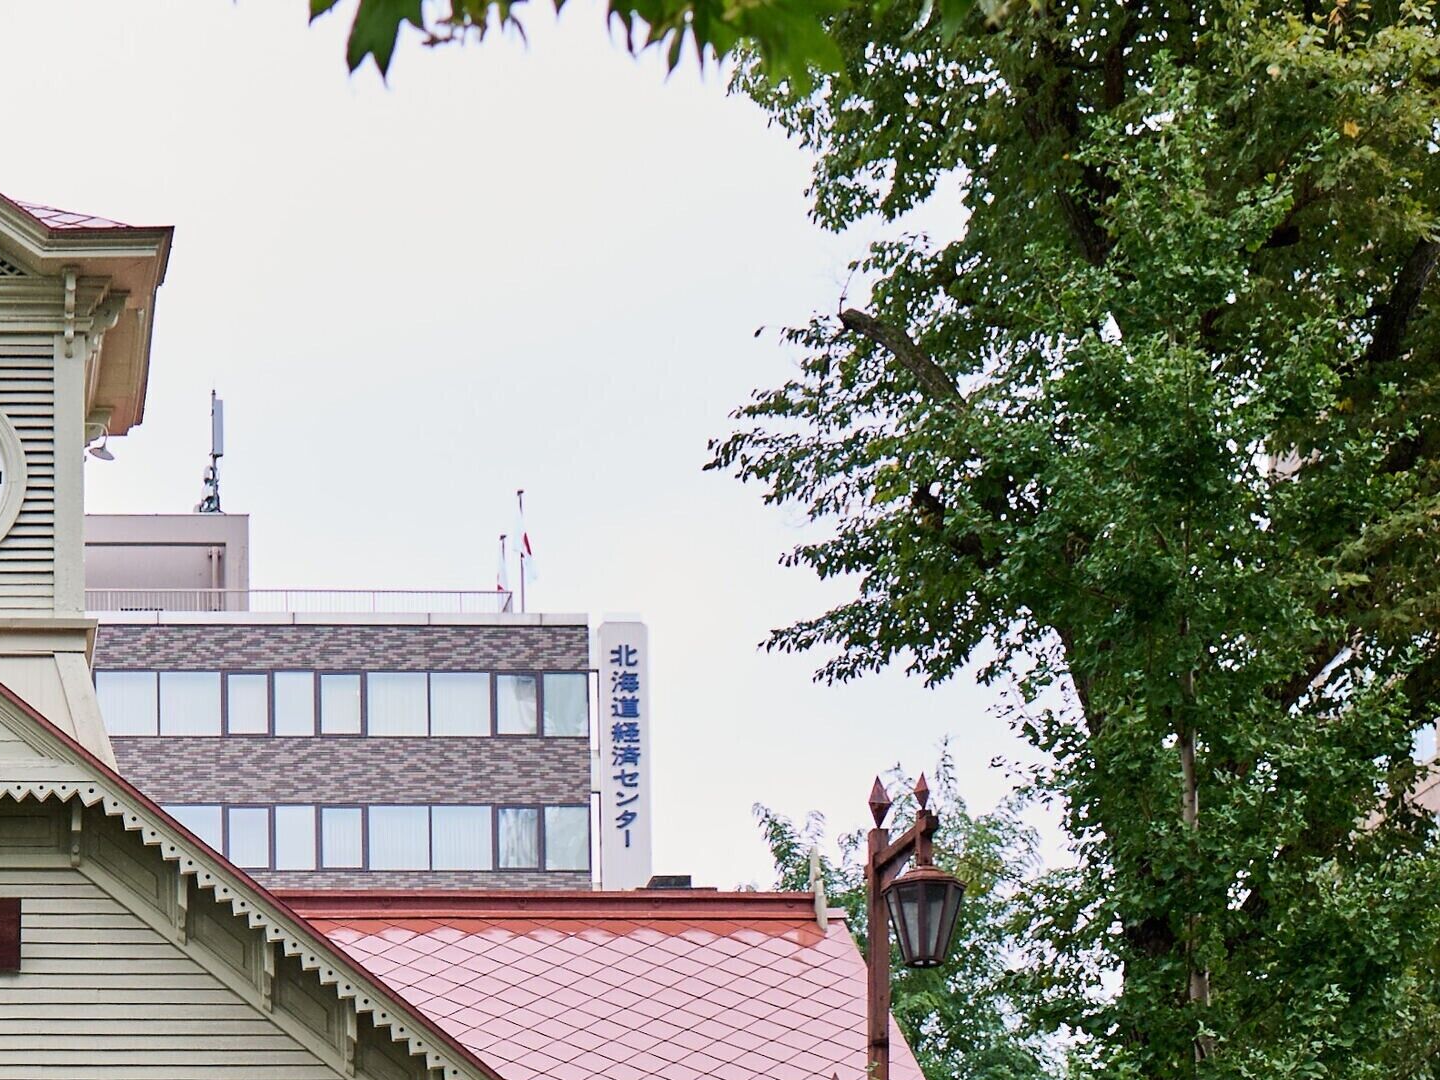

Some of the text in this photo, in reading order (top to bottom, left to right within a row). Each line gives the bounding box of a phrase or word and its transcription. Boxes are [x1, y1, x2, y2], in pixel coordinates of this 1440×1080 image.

[610, 645, 641, 848] 北海道経済センター
